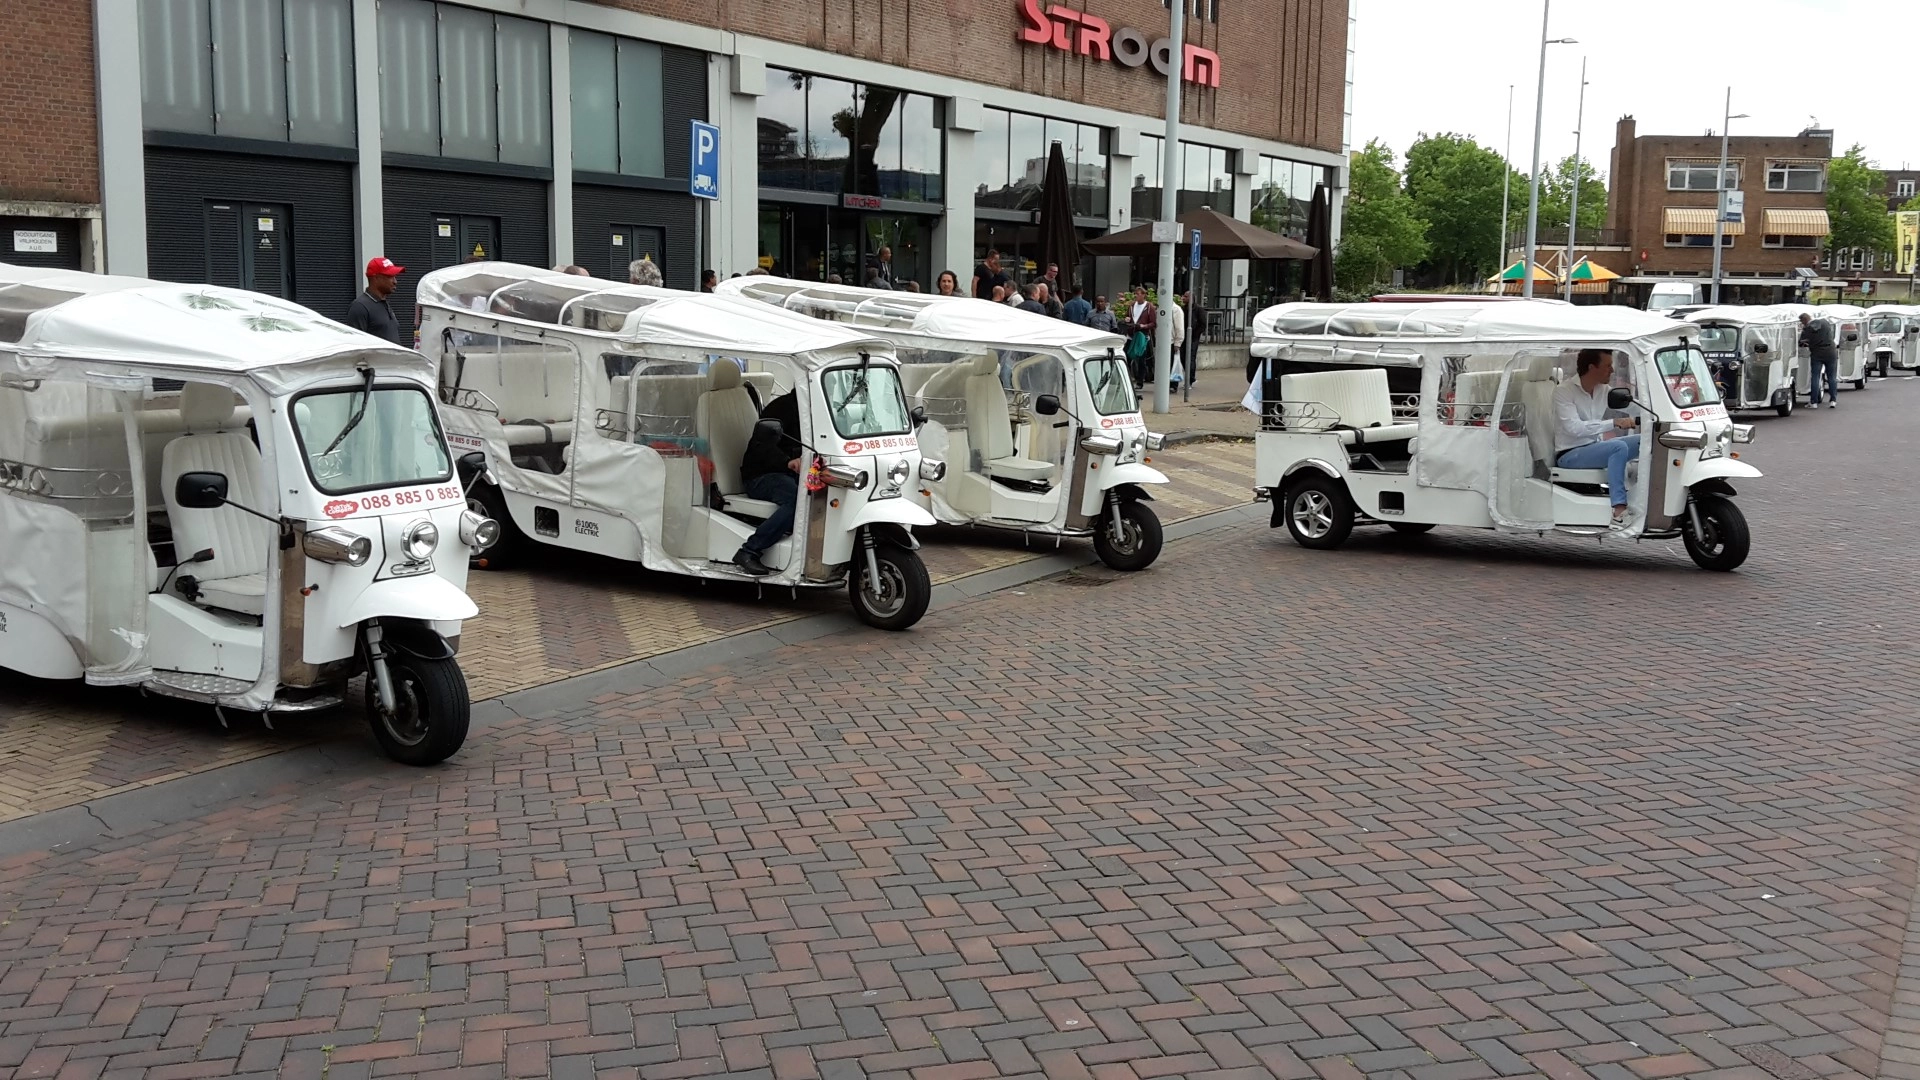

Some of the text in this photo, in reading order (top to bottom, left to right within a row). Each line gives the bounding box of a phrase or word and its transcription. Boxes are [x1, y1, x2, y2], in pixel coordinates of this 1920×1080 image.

[698, 129, 714, 166] P
[864, 440, 880, 450] 088
[882, 438, 897, 448] 885
[898, 437, 904, 447] 0
[904, 437, 917, 447] 885
[361, 486, 461, 510] 088 885 0 885
[574, 526, 600, 538] ELECTRIC
